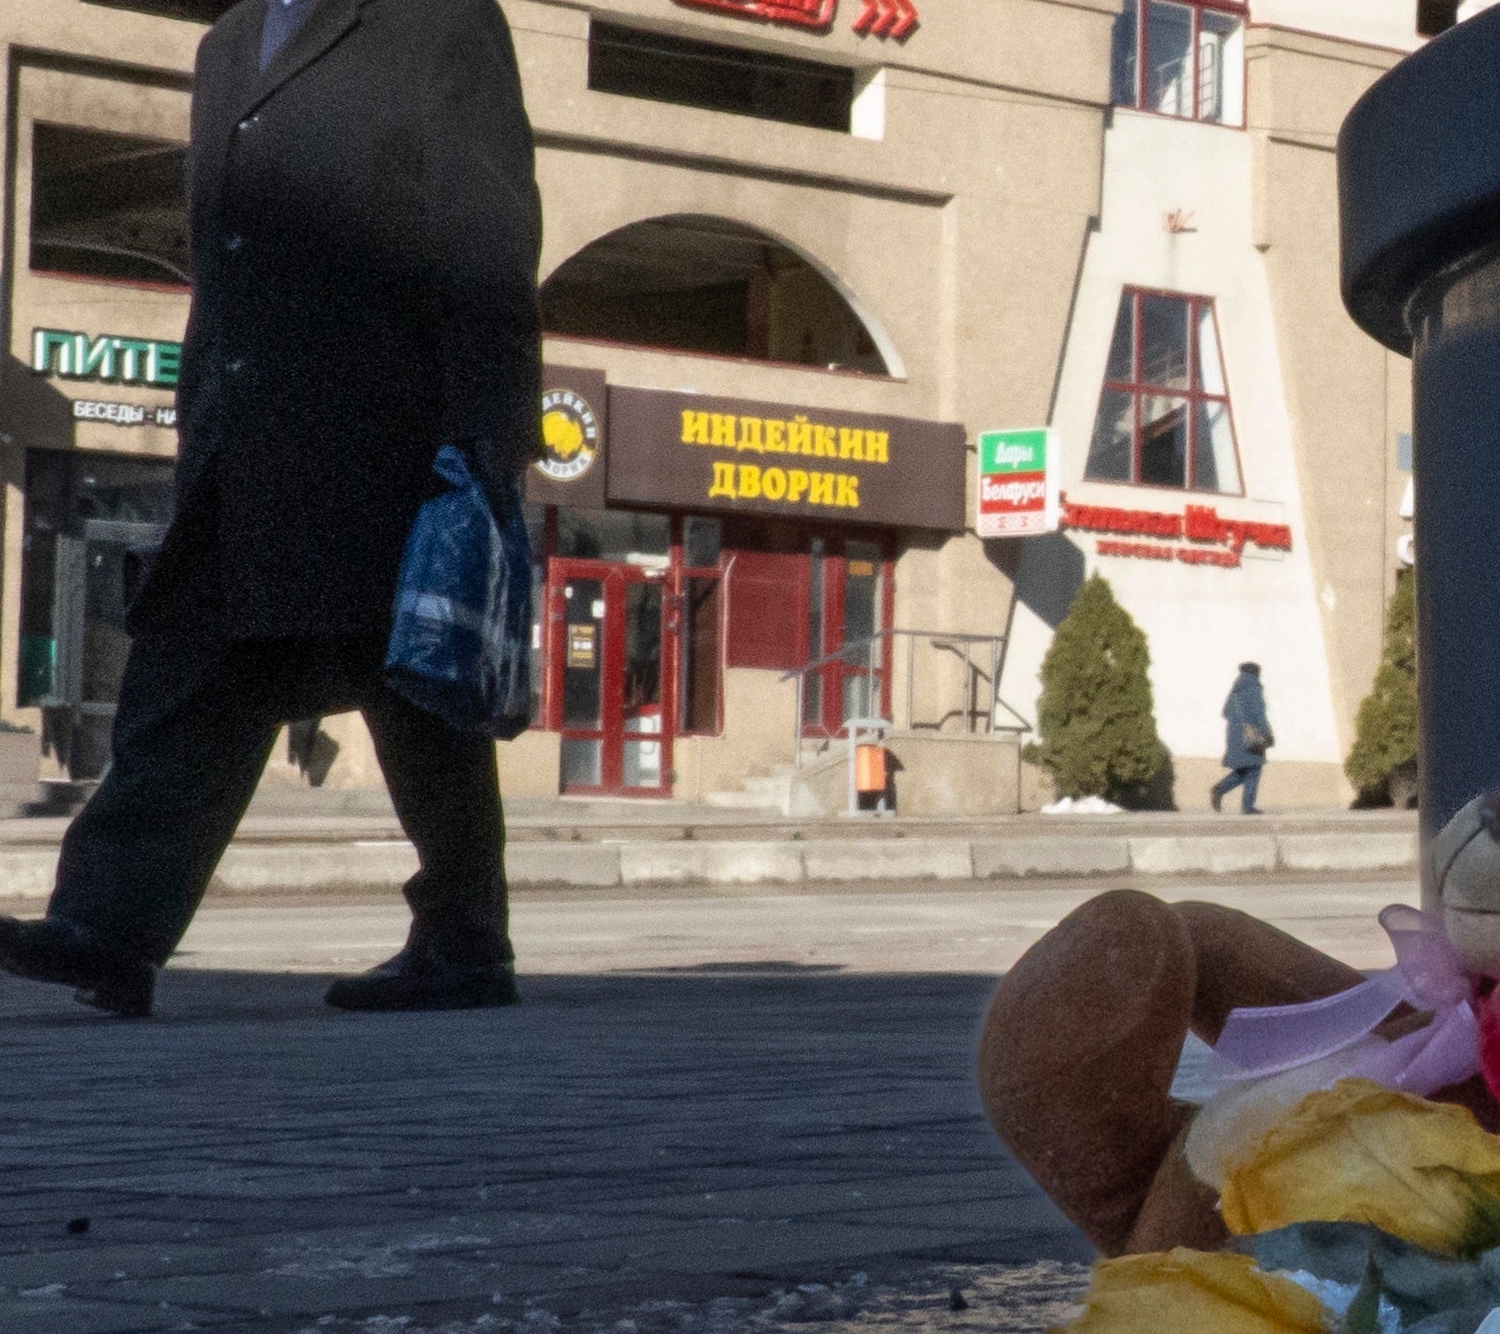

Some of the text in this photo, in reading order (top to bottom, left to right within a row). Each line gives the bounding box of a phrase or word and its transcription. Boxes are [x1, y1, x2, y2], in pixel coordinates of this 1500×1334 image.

[32, 328, 182, 385] ПИТЕ
[73, 400, 145, 424] БЕСЕДЫ
[156, 407, 177, 424] НА
[681, 409, 889, 464] ИНДЕЙКИН
[708, 461, 860, 508] ДВОРИК
